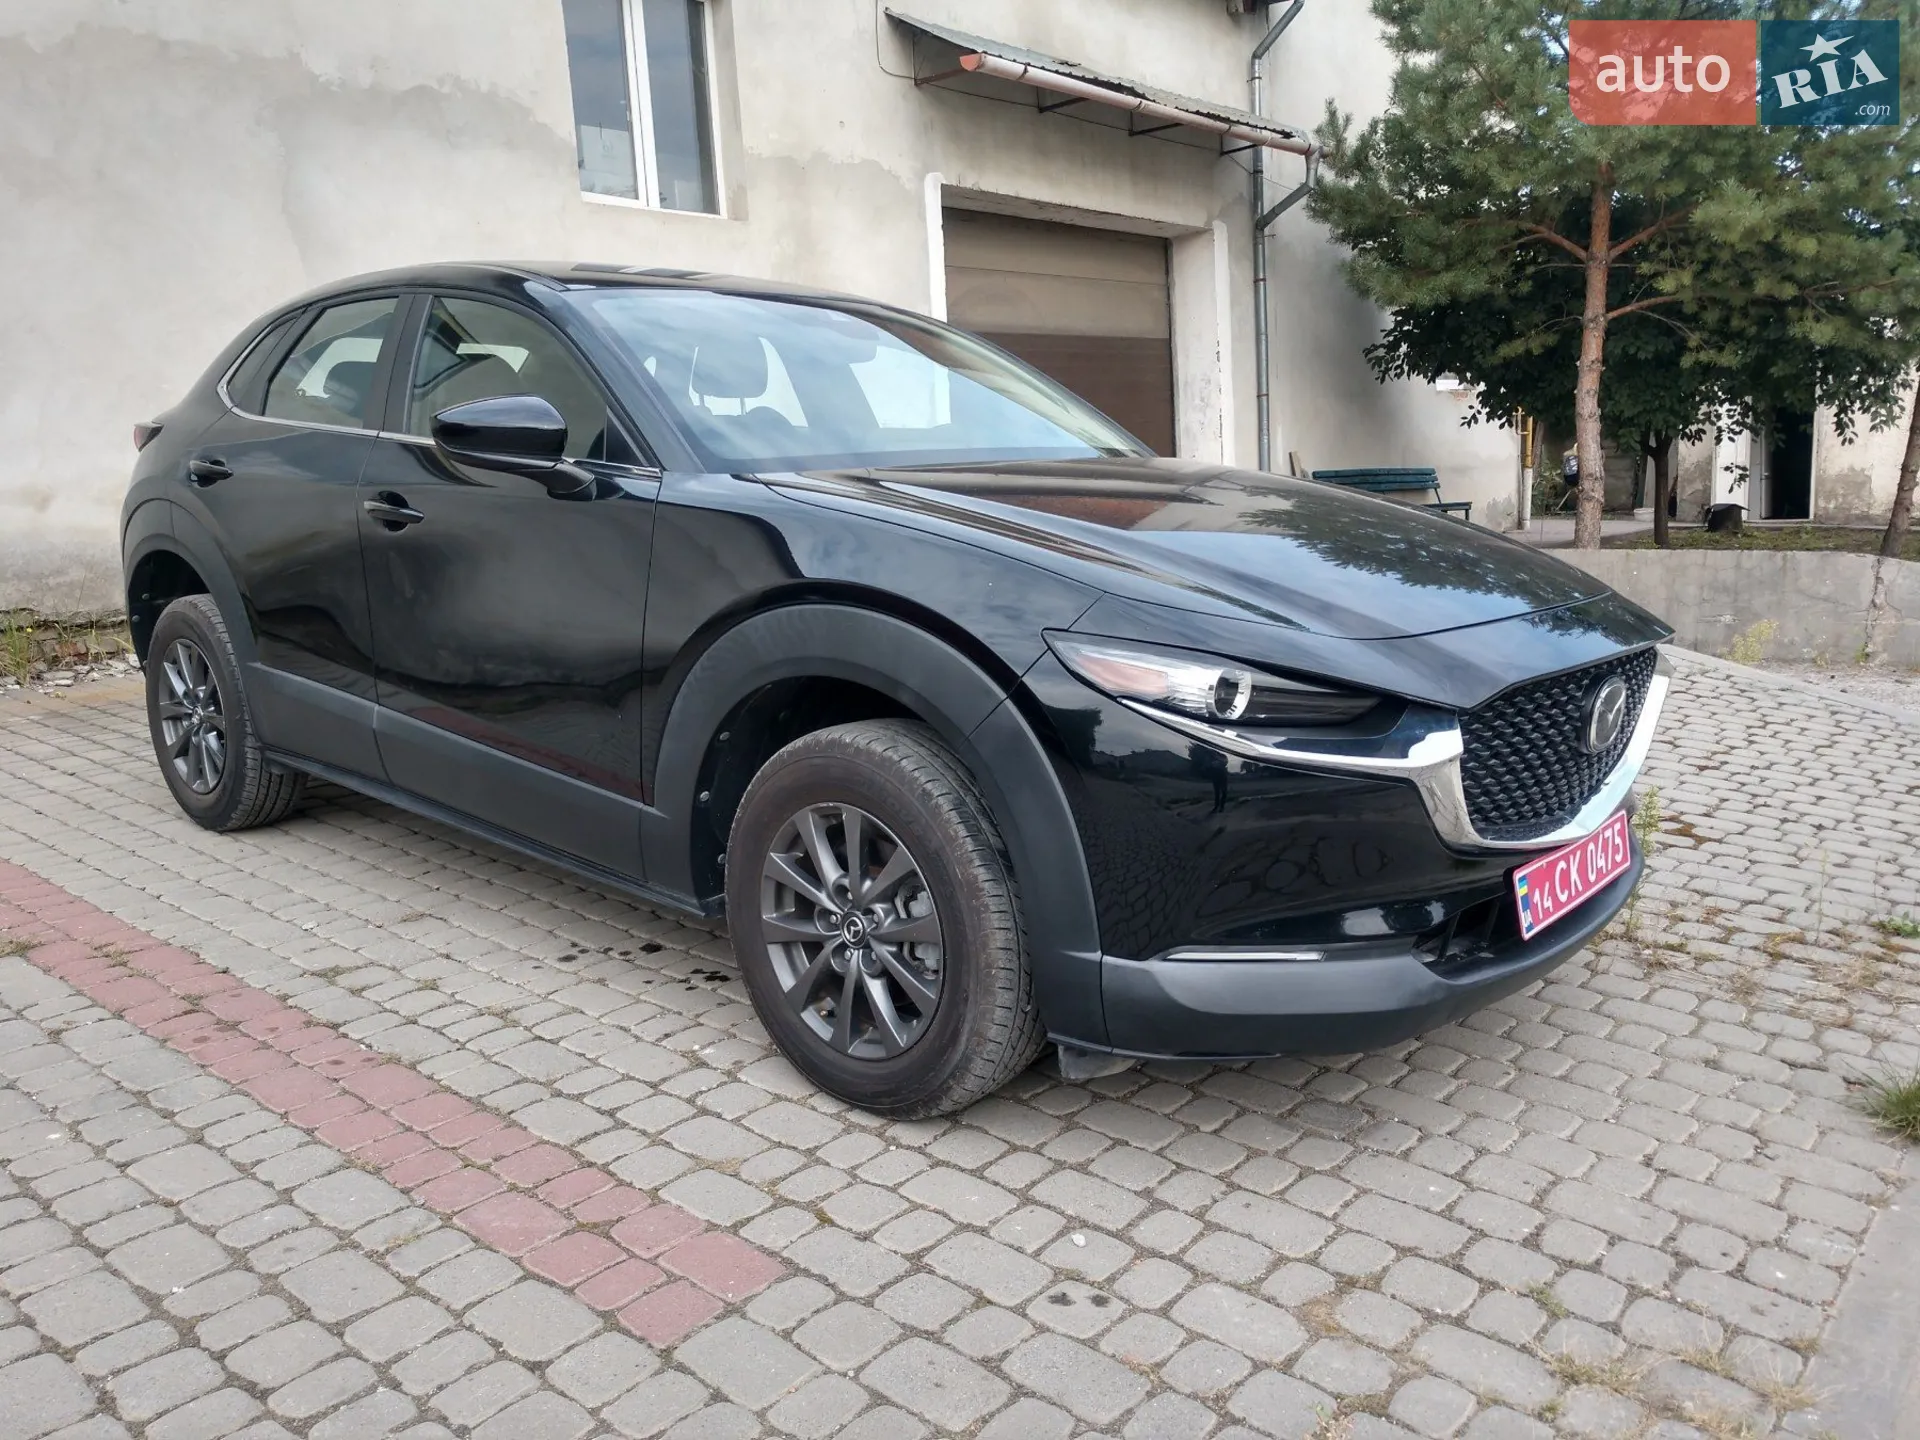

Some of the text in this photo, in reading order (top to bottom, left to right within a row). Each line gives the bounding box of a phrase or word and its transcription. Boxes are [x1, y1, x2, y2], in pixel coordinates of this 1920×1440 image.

[1533, 822, 1624, 920] 14 CK 0475
